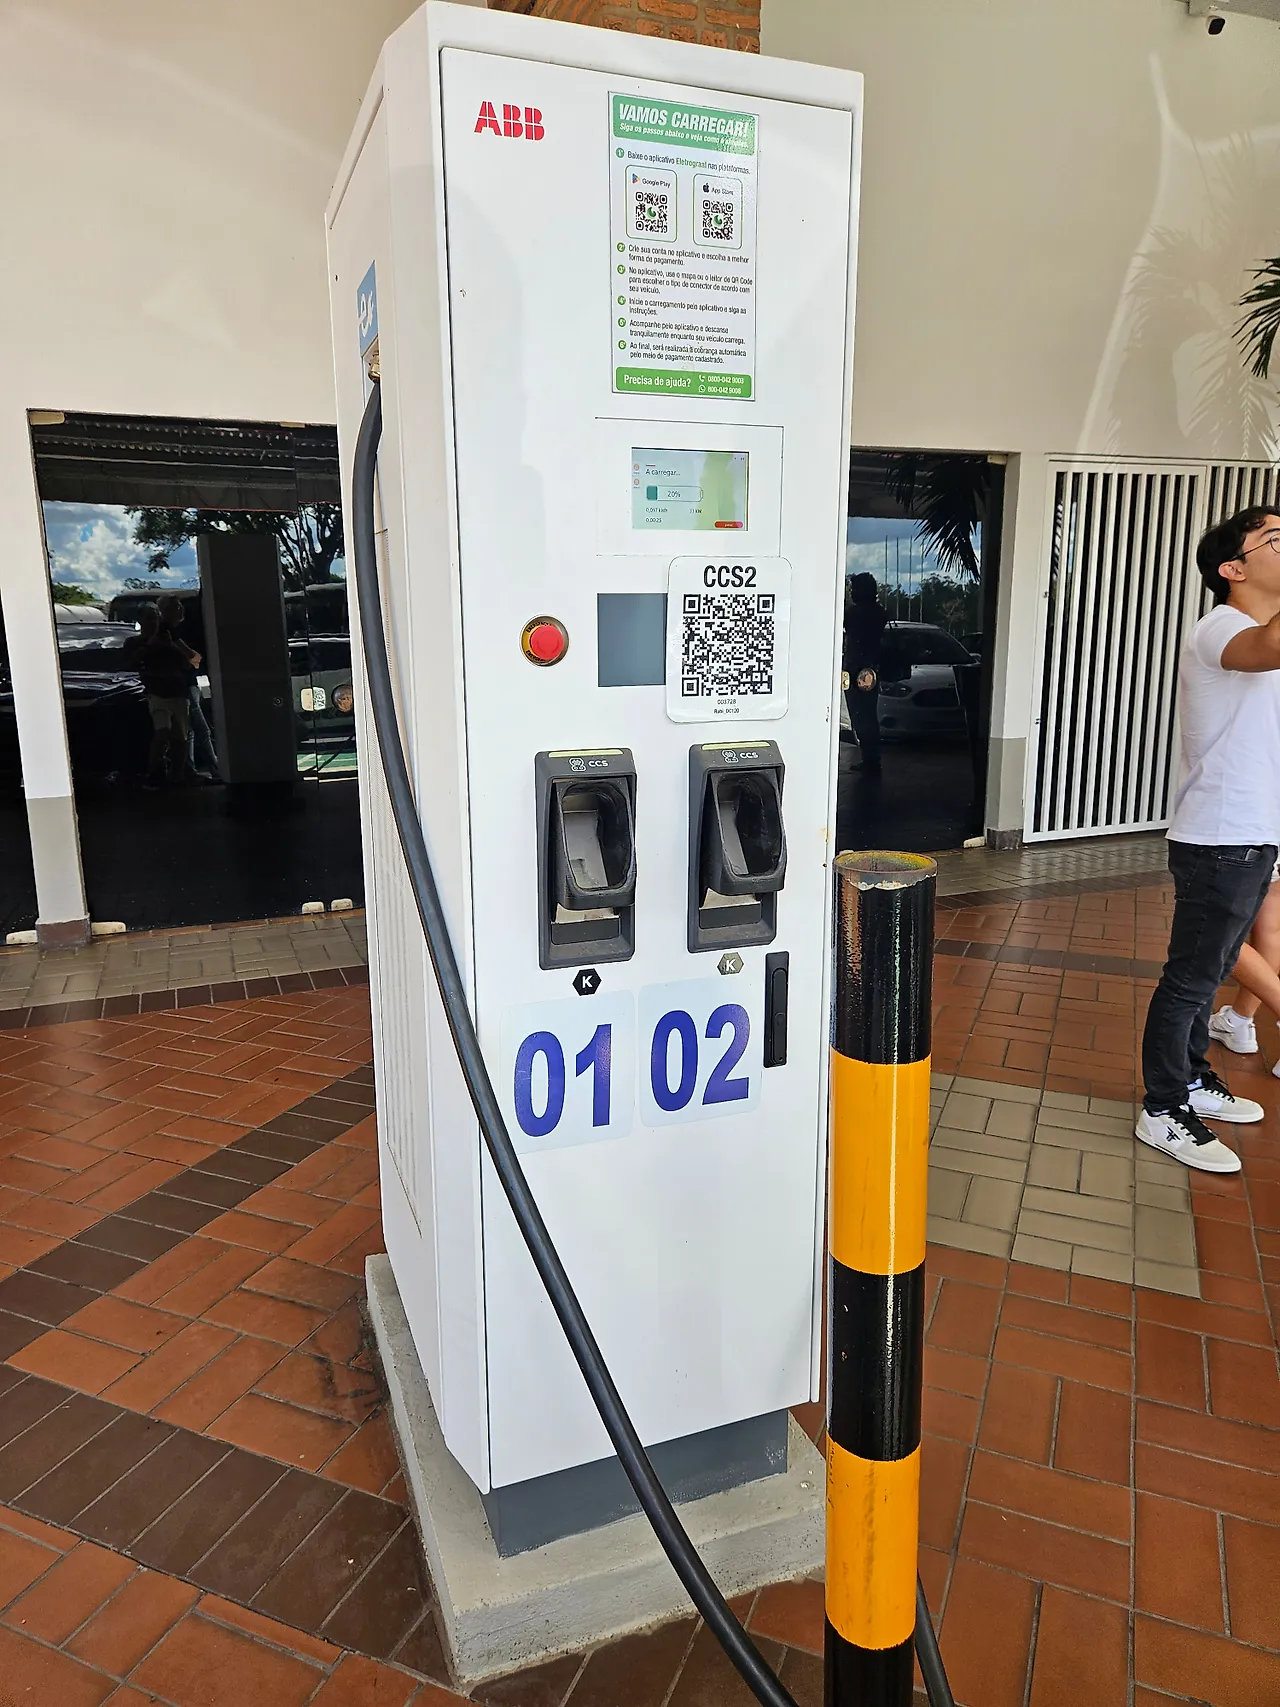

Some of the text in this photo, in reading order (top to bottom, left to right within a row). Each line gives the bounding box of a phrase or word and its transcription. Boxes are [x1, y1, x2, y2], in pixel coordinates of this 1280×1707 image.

[474, 101, 545, 141] ABB
[618, 103, 749, 138] VAMOS CARREGAR!
[619, 122, 634, 133] Siga
[643, 127, 664, 136] passos
[664, 129, 685, 139] abaixo
[690, 133, 703, 142] veja
[703, 135, 720, 143] como
[627, 150, 643, 160] Baixe
[648, 154, 675, 165] aplicativo
[642, 178, 671, 189] Google Play
[711, 187, 734, 196] App Store
[628, 244, 640, 253] Crie
[640, 246, 651, 254] sua
[651, 247, 667, 255] conta
[675, 249, 701, 259] aplicativo
[731, 255, 750, 264] melhor
[628, 253, 645, 262] forma
[653, 256, 686, 266] pagamento.
[637, 268, 665, 278] aplicativo,
[681, 272, 697, 280] mapa
[709, 273, 723, 282] leitor
[739, 276, 753, 286] Code
[628, 276, 642, 284] para
[642, 277, 666, 286] escolher
[670, 279, 681, 288] tipo
[689, 281, 713, 291] conector
[720, 284, 738, 293] acordo
[739, 286, 751, 294] com
[628, 285, 640, 293] seu
[648, 300, 686, 309] carregamento
[686, 302, 698, 311] pelo
[698, 303, 724, 313] aplicativo
[728, 305, 740, 315] siga
[629, 319, 661, 329] Acompanhe
[661, 322, 673, 331] pelo
[674, 322, 700, 332] aplicativo
[629, 329, 670, 339] tranquilamente
[670, 331, 695, 341] enquanto
[695, 334, 705, 342] seu
[724, 337, 746, 346] carrega.
[638, 341, 652, 352] final,
[652, 343, 664, 351] será
[664, 344, 689, 353] realizada
[629, 351, 642, 359] pelo
[642, 351, 657, 360] meio
[664, 353, 694, 362] pagamento
[694, 355, 725, 364] cadastrado.
[623, 374, 692, 389] Precisa de ajuda?
[667, 490, 681, 498] 20%
[703, 565, 757, 588] CCS2
[588, 759, 608, 767] CCS
[725, 959, 737, 972] K
[582, 975, 594, 988] K
[650, 1003, 751, 1112] 02
[514, 1023, 612, 1137] 01
